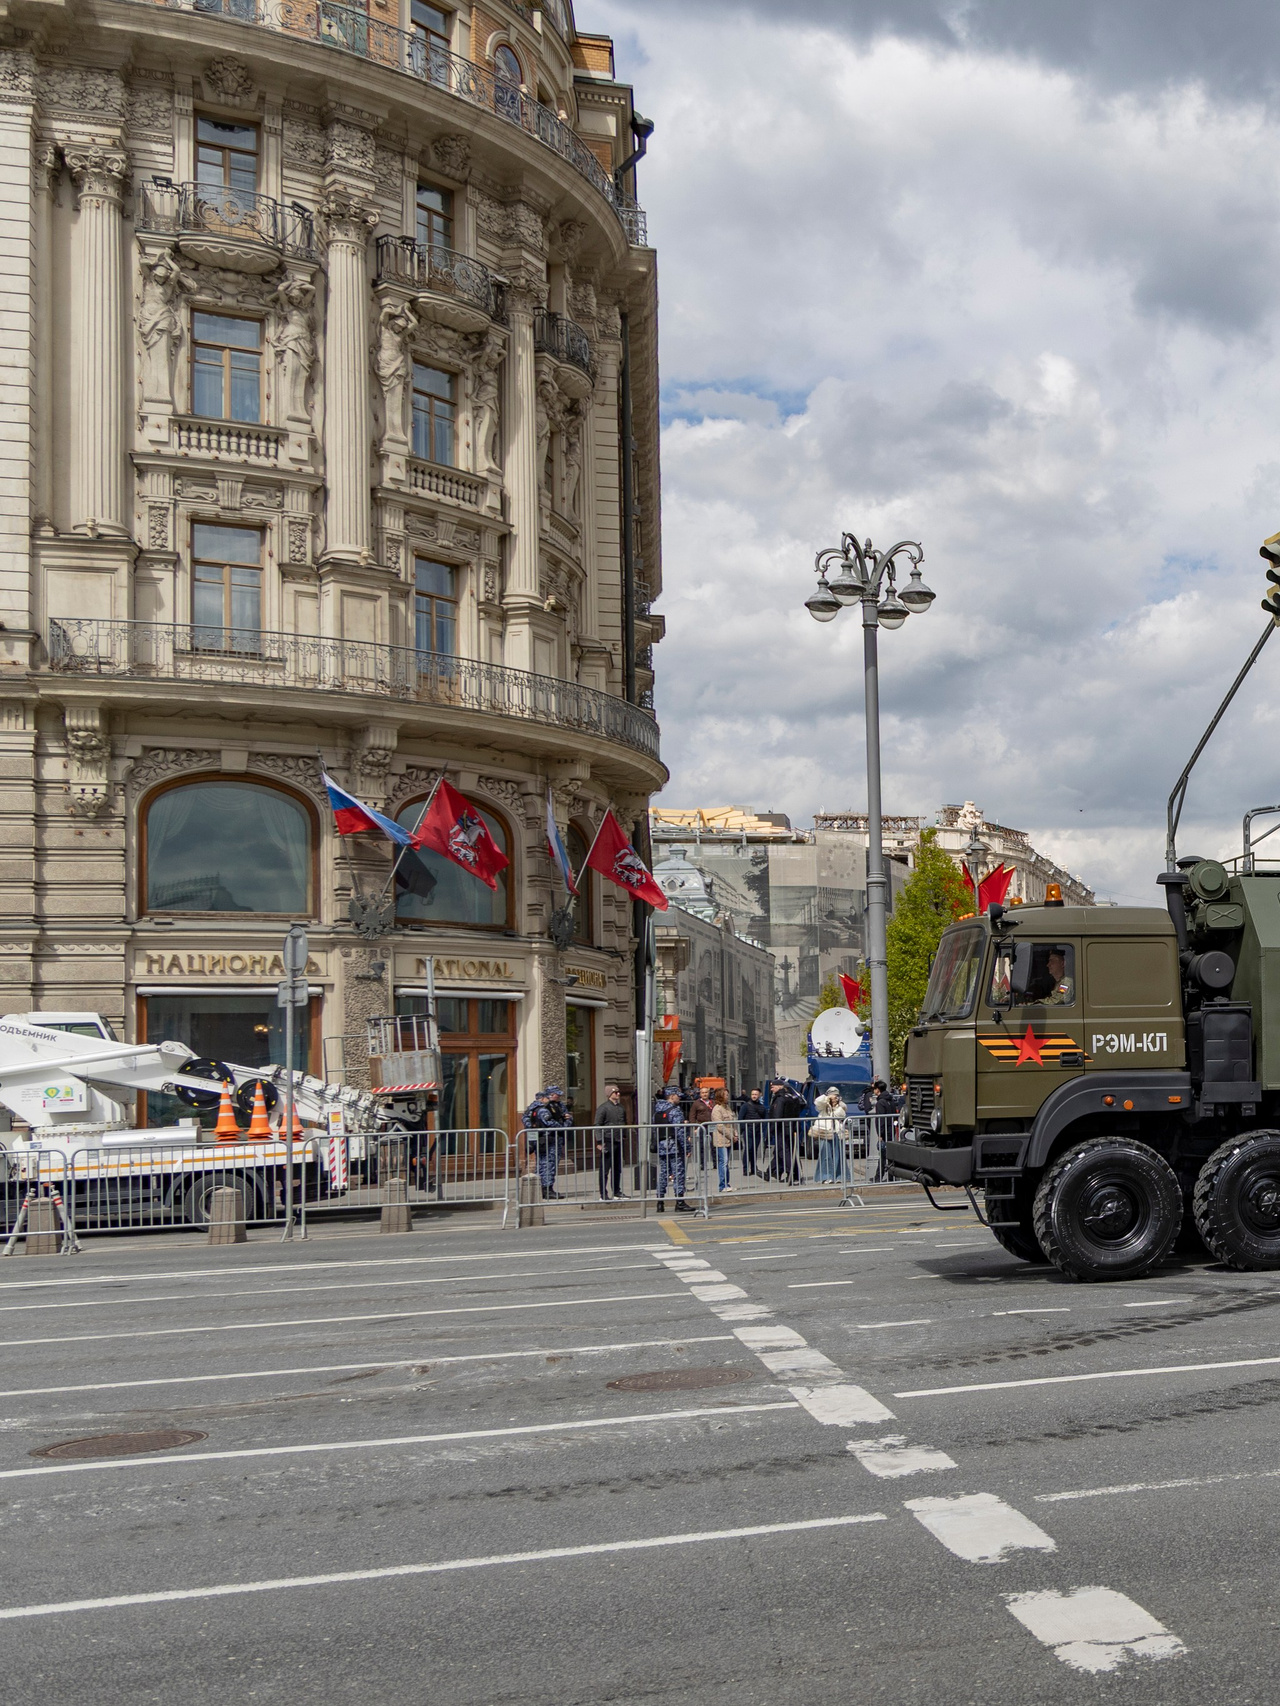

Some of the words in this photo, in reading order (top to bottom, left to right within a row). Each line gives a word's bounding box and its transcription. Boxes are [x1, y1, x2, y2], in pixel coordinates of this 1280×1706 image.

[146, 954, 320, 976] НАЦИОНАЬ
[415, 958, 514, 978] NATIONAL
[0, 1025, 58, 1042] ОДЪЕМНИК
[1092, 1032, 1168, 1054] РЭМ-КЛ
